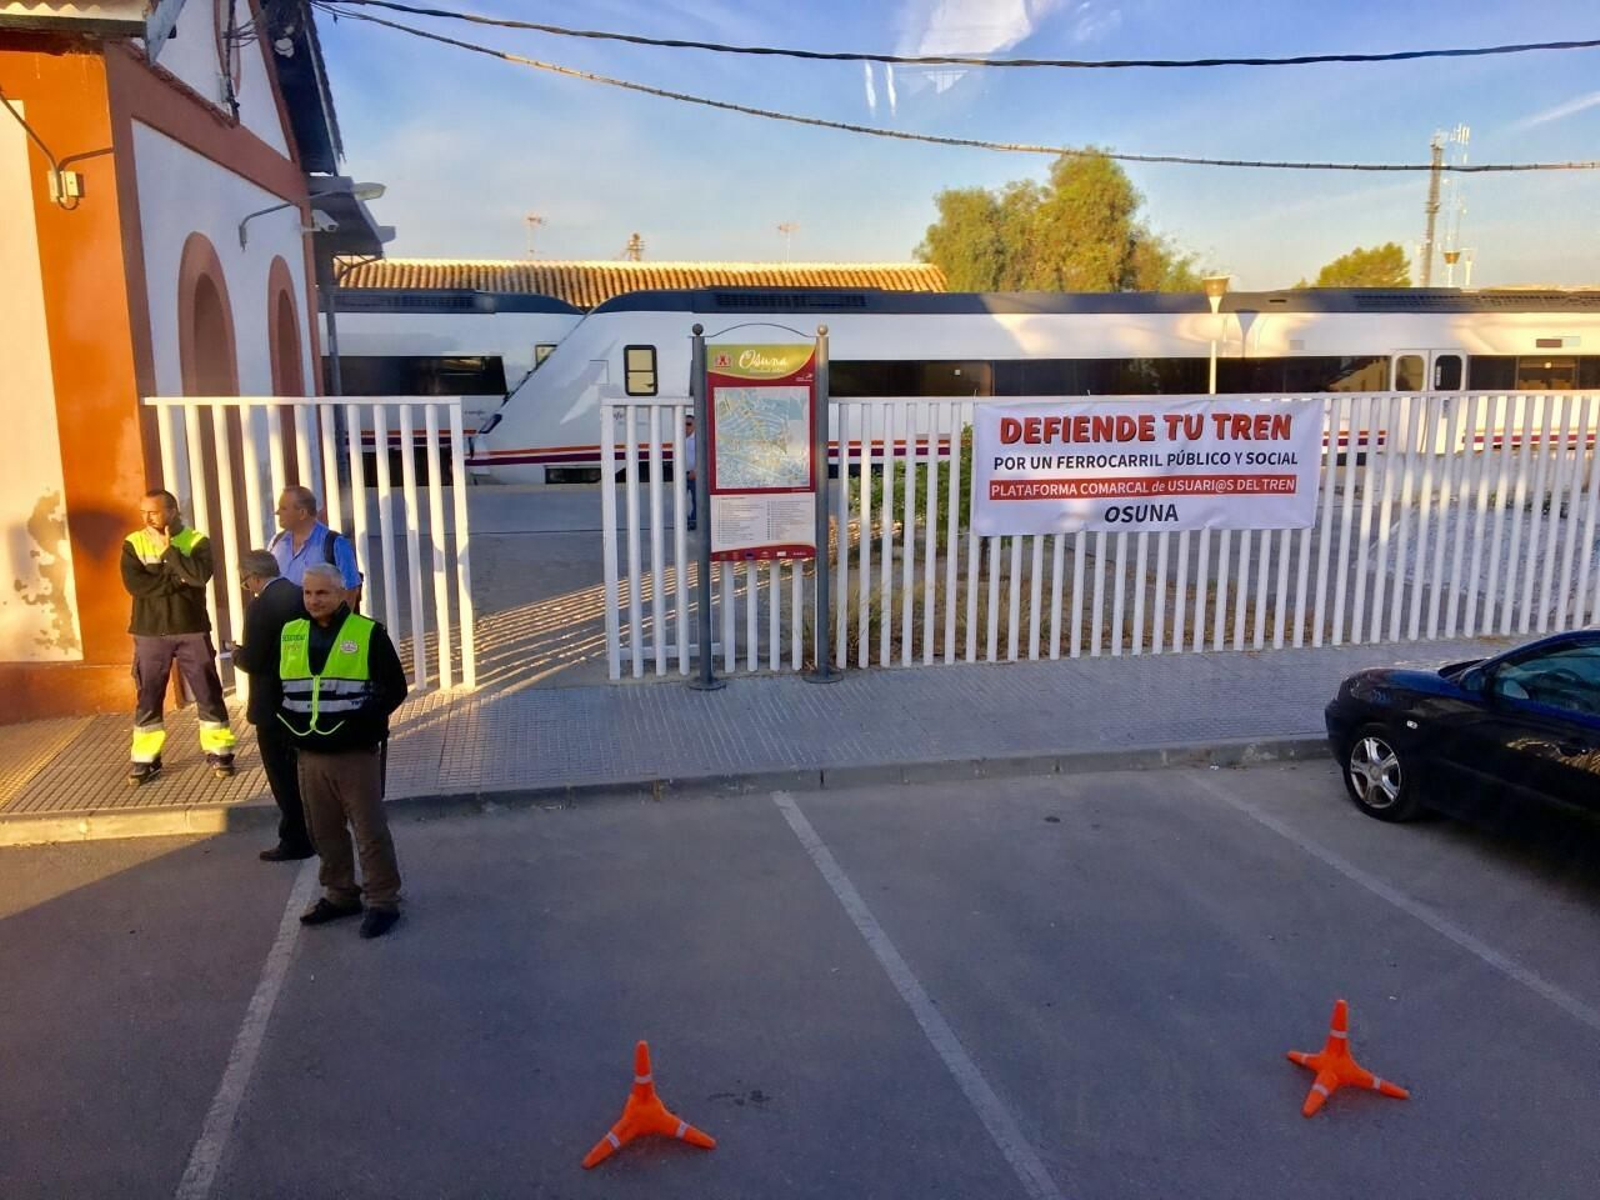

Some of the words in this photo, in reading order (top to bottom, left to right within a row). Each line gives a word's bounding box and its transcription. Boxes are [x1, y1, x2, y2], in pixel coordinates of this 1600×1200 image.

[738, 349, 788, 369] Osuna
[1000, 415, 1156, 445] DEFIENDE
[1163, 413, 1204, 441] TU
[1211, 413, 1292, 441] TREN
[994, 456, 1026, 470] POR
[1030, 456, 1053, 469] UN
[1056, 454, 1163, 469] FERROCARRIL
[1167, 450, 1231, 467] PÚBLICO
[1234, 452, 1243, 465] Y
[1245, 452, 1298, 465] SOCIAL
[991, 483, 1078, 497] PLATAFORMA
[1080, 481, 1150, 496] COMARCAL
[1151, 480, 1166, 492] de
[1168, 479, 1235, 493] USUARI@S
[1236, 479, 1261, 491] DEL
[1263, 478, 1295, 491] TREN
[1104, 503, 1179, 523] OSUNA
